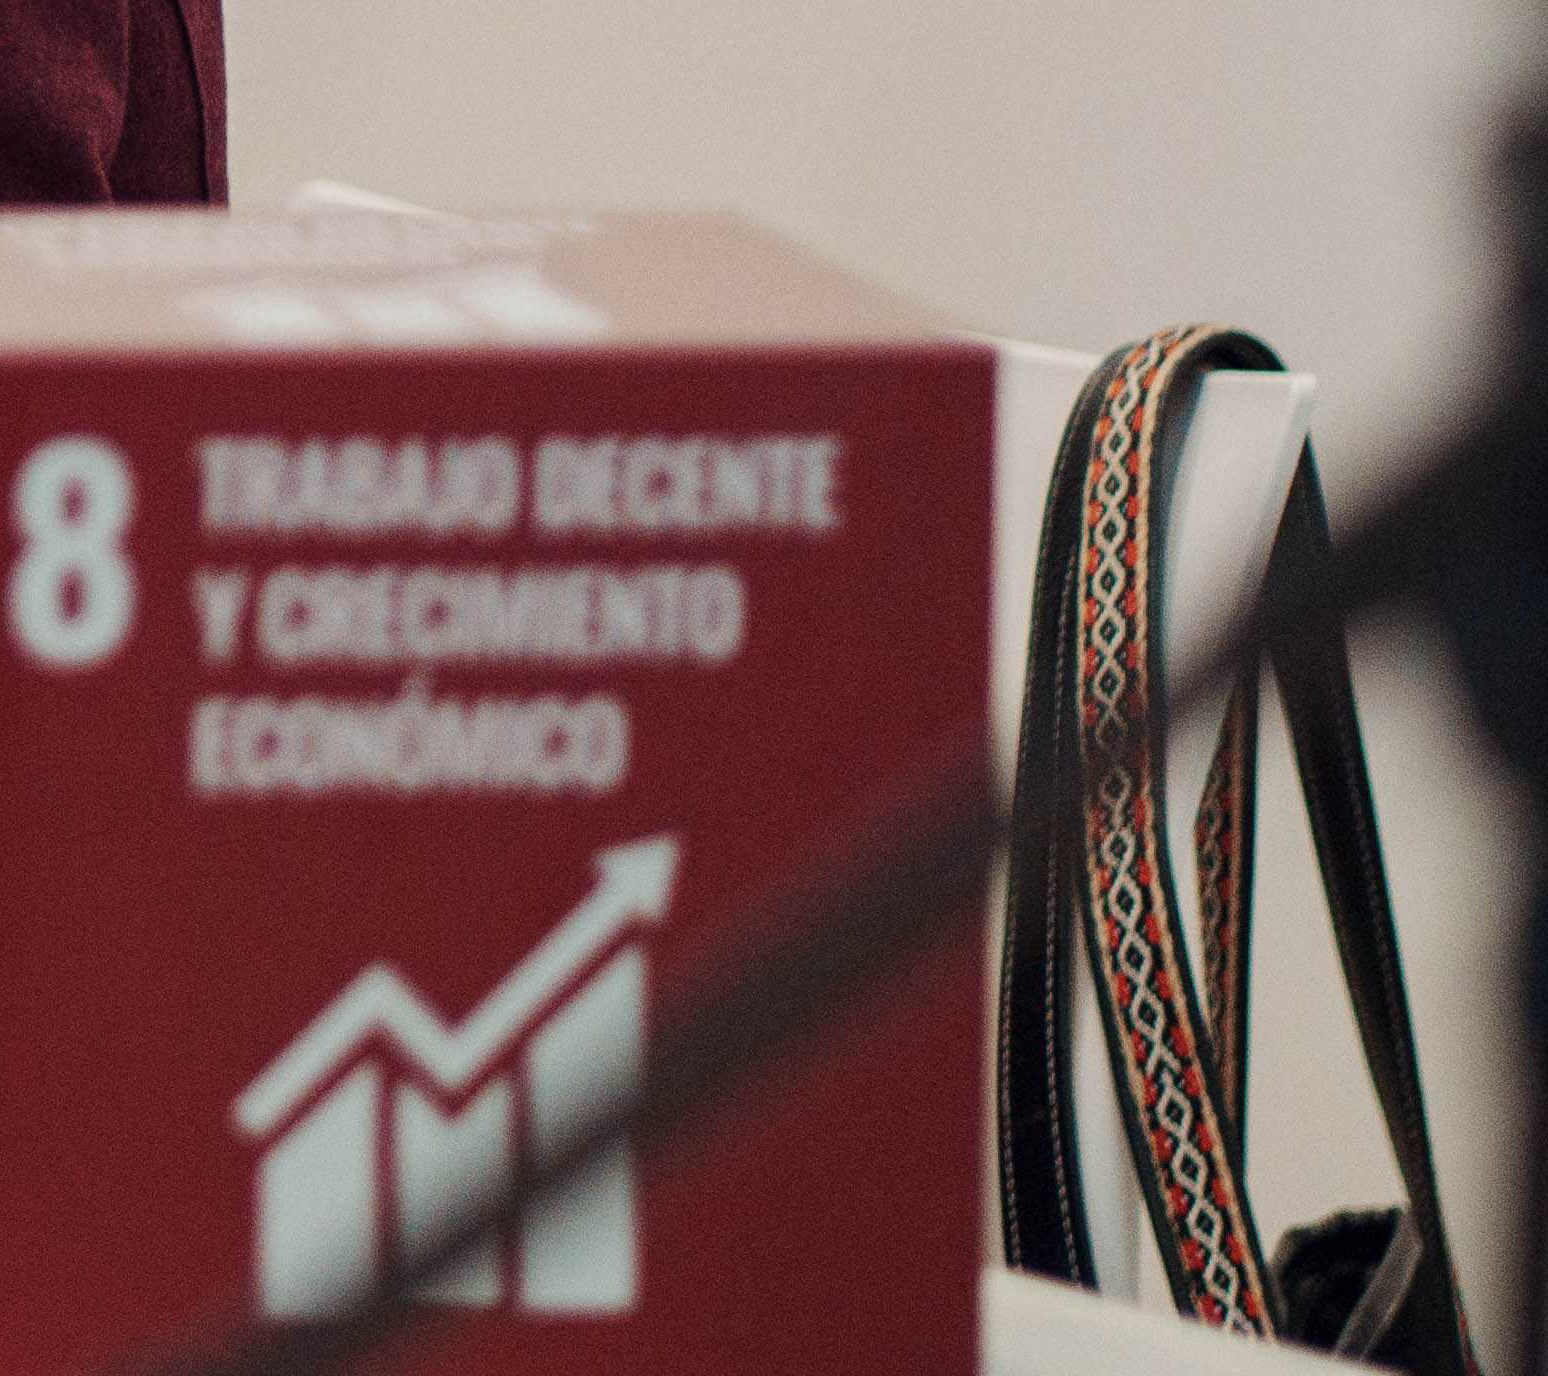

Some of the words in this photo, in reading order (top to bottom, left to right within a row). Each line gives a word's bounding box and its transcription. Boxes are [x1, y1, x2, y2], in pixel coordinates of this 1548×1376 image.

[194, 433, 524, 534] TRABAJO
[529, 433, 843, 534] DECENTE
[8, 433, 136, 669] 8
[190, 564, 248, 662] Y
[253, 562, 748, 668] CRECIMIENTO
[187, 668, 632, 796] ECONÓMICO
